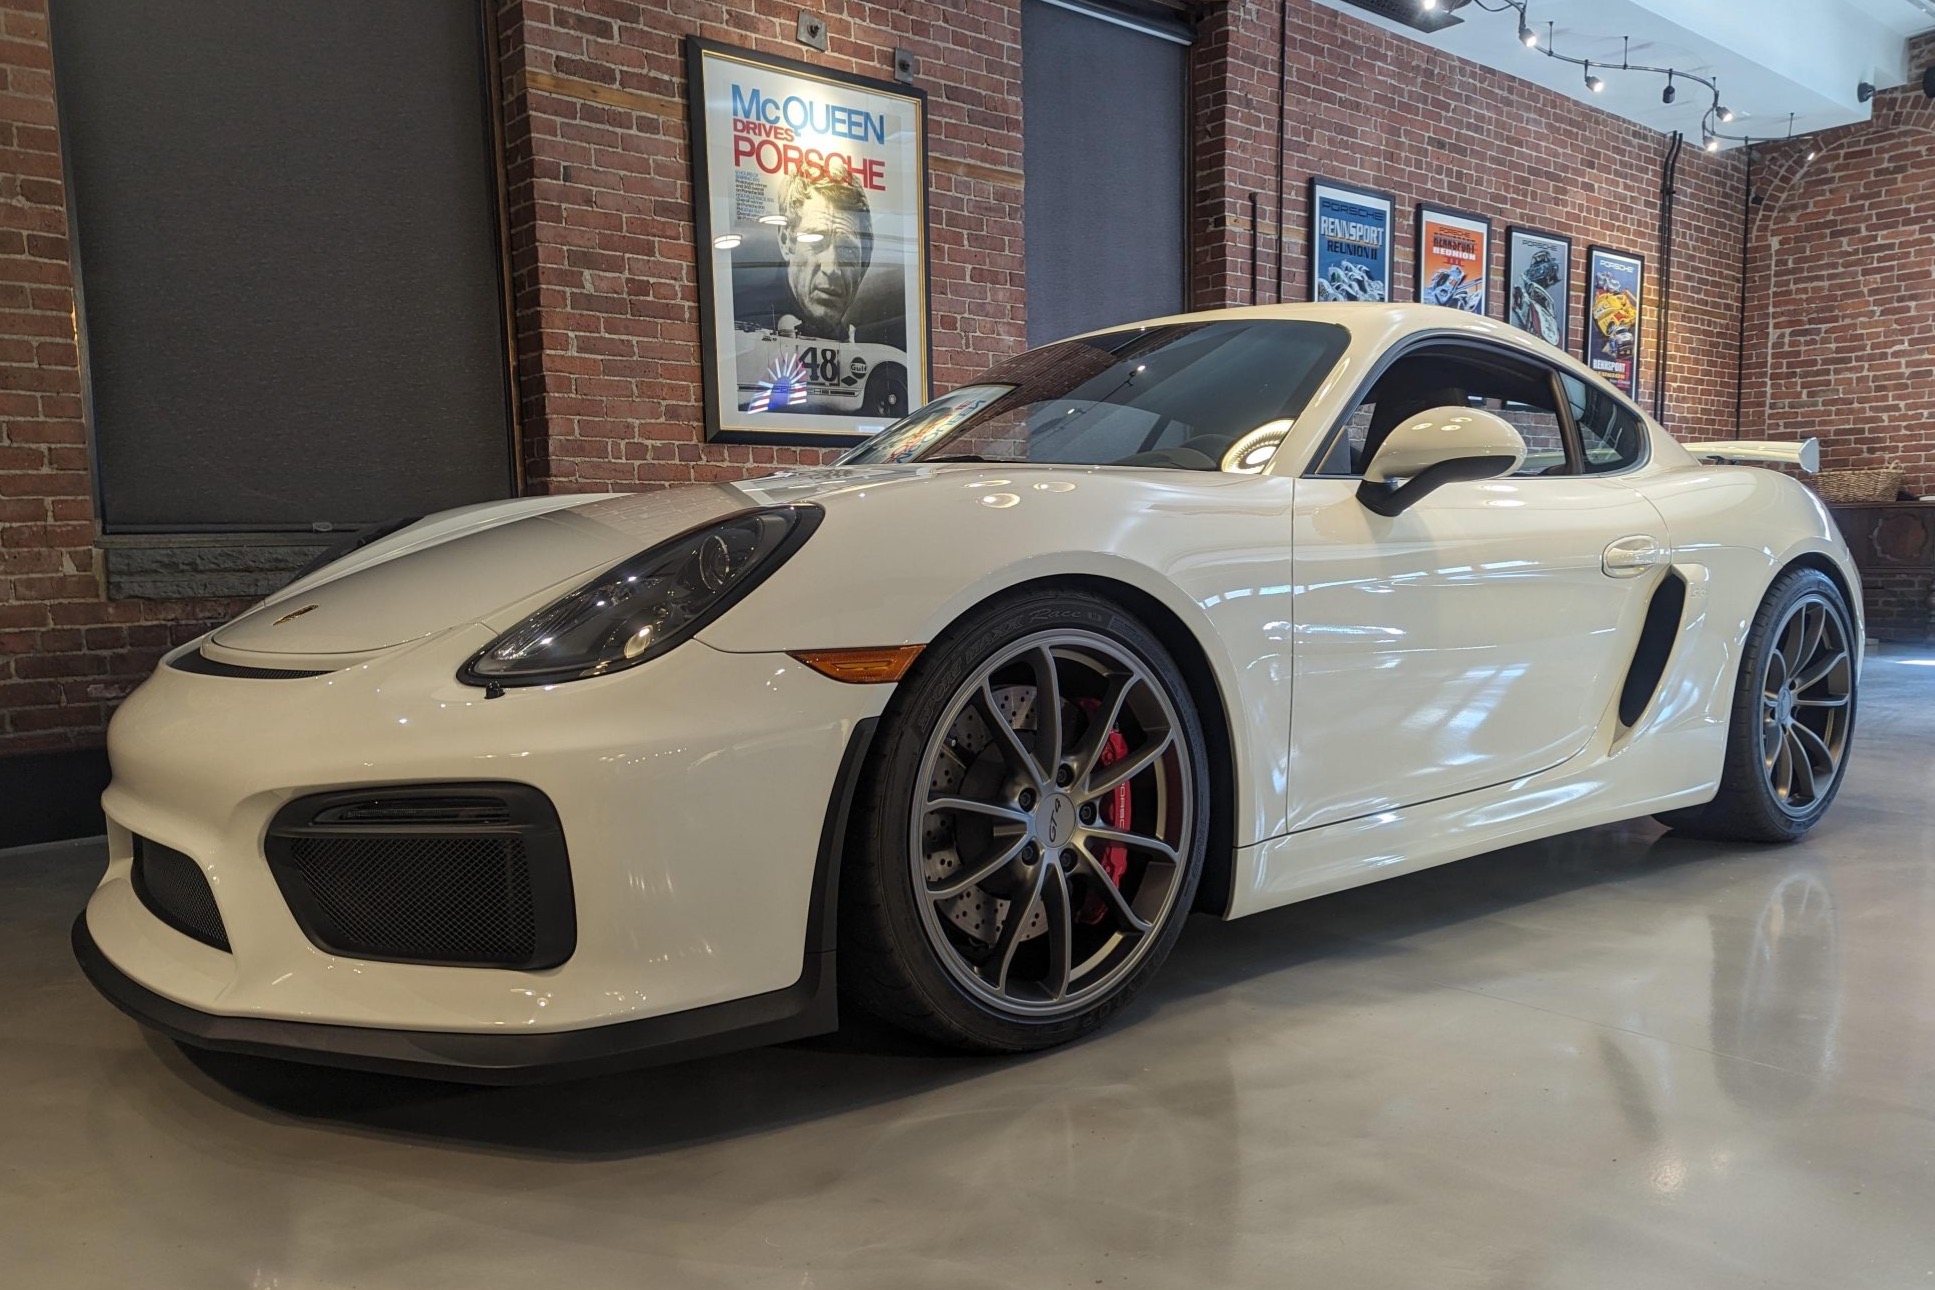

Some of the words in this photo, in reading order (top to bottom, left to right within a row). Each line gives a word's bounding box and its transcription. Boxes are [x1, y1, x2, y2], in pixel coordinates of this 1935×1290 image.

[731, 84, 885, 145] McQUEEN
[733, 118, 795, 142] DRIVES
[734, 135, 886, 191] PORSCHE
[1321, 200, 1384, 222] PORSCHE
[1320, 215, 1385, 247] RENNSPORT
[1327, 239, 1370, 259] REUNION
[1370, 247, 1378, 260] II
[1432, 246, 1476, 261] REUNION
[1522, 239, 1558, 252] PORSCHE
[1600, 259, 1634, 273] PORSCHE
[797, 346, 838, 383] 48
[850, 363, 867, 373] Gulf
[1592, 358, 1626, 373] RENNSPORT
